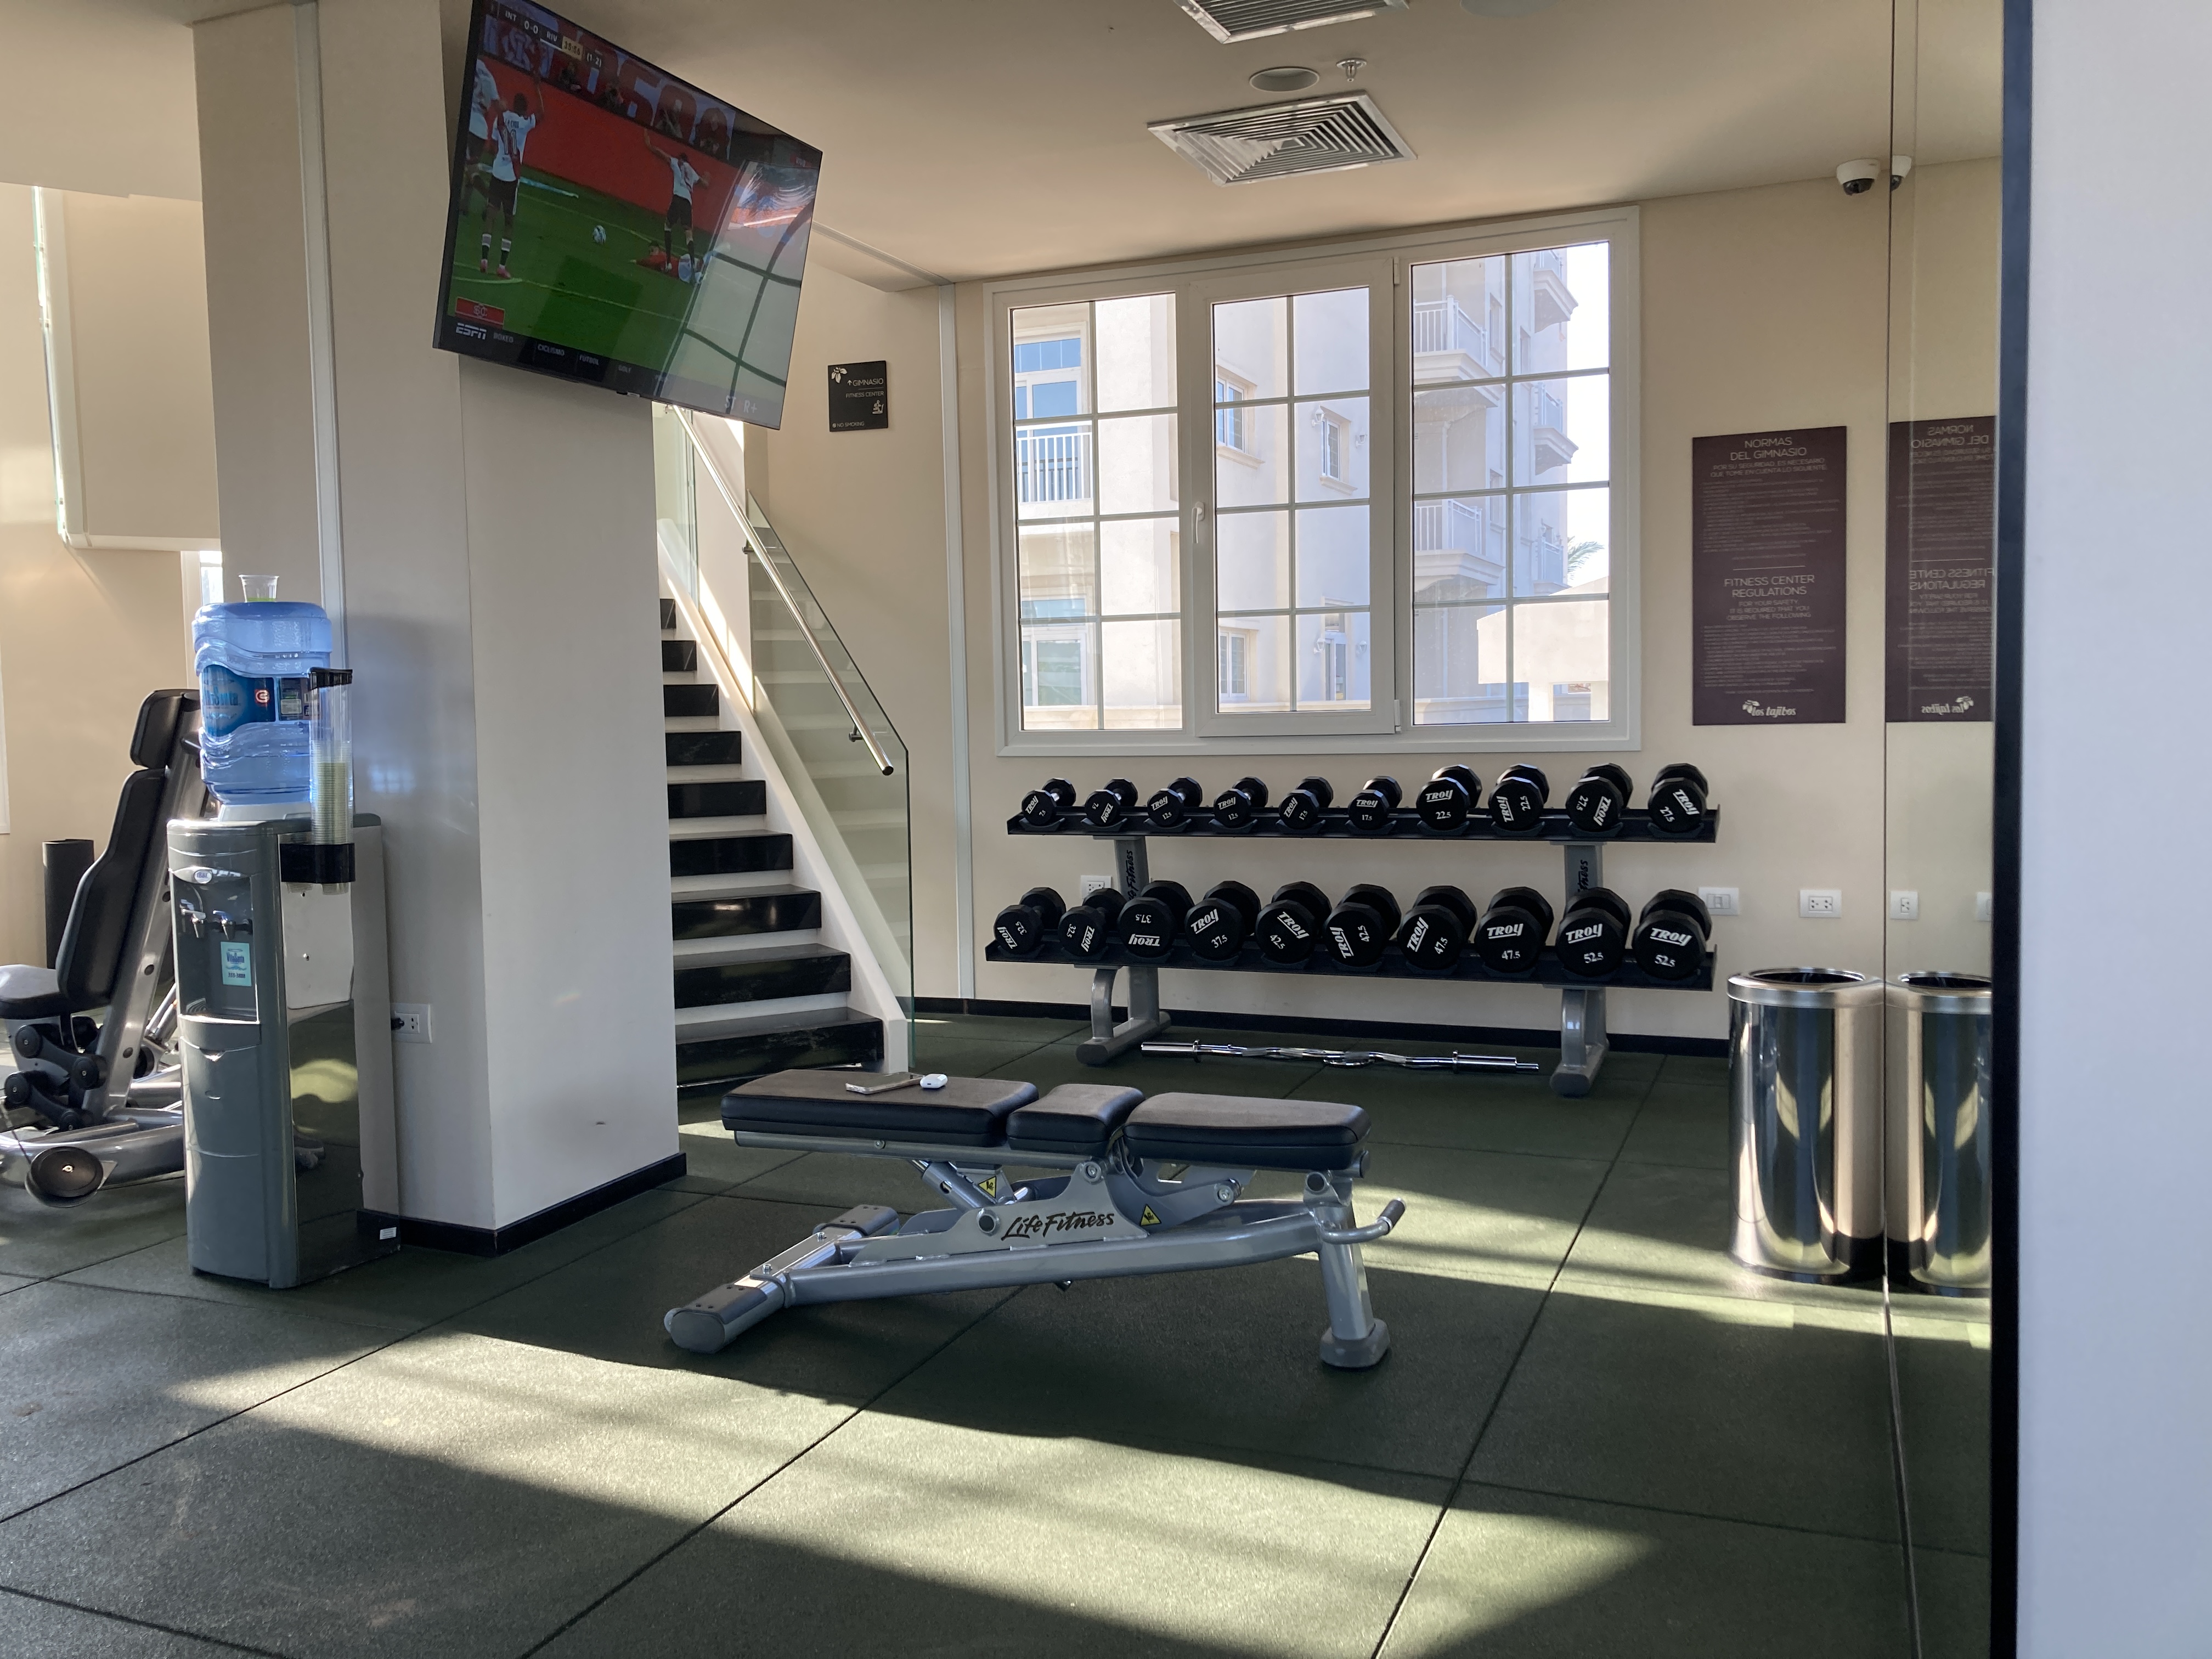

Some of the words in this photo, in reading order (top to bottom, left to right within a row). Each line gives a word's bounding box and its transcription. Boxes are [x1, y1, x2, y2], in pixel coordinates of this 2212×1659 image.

[505, 10, 517, 22] INT
[546, 31, 558, 42] RIV
[455, 323, 487, 340] ESPN
[853, 378, 884, 386] GIMNASIO
[724, 394, 758, 414] STR+
[1745, 437, 1792, 448] NORMAS
[1730, 451, 1751, 461] DEL
[1753, 447, 1807, 459] GIMNASIO
[1724, 577, 1769, 587] FITNESS
[1771, 575, 1815, 585] CENTER
[1732, 586, 1807, 597] REGULATIONS
[1025, 795, 1039, 814] TROY
[1150, 796, 1168, 811] TROY
[1217, 797, 1235, 810] TROY
[1356, 799, 1378, 808] TROY
[1425, 790, 1453, 802] TROY
[1673, 789, 1700, 815] TROY
[1101, 803, 1114, 823] TROY
[1283, 797, 1298, 818] TROY
[1496, 795, 1514, 822] TROY
[1593, 796, 1612, 826] TROY
[1577, 860, 1589, 893] tness
[1190, 909, 1219, 934] TROY
[1277, 911, 1310, 939] TROY
[1487, 923, 1523, 939] TROY
[996, 926, 1017, 949] TROY
[1081, 926, 1095, 952] TROY
[1128, 933, 1160, 946] TROY
[1329, 927, 1354, 959] TROY
[1407, 916, 1429, 952] TROY
[1565, 923, 1603, 944] TROY
[1650, 927, 1692, 946] TROY
